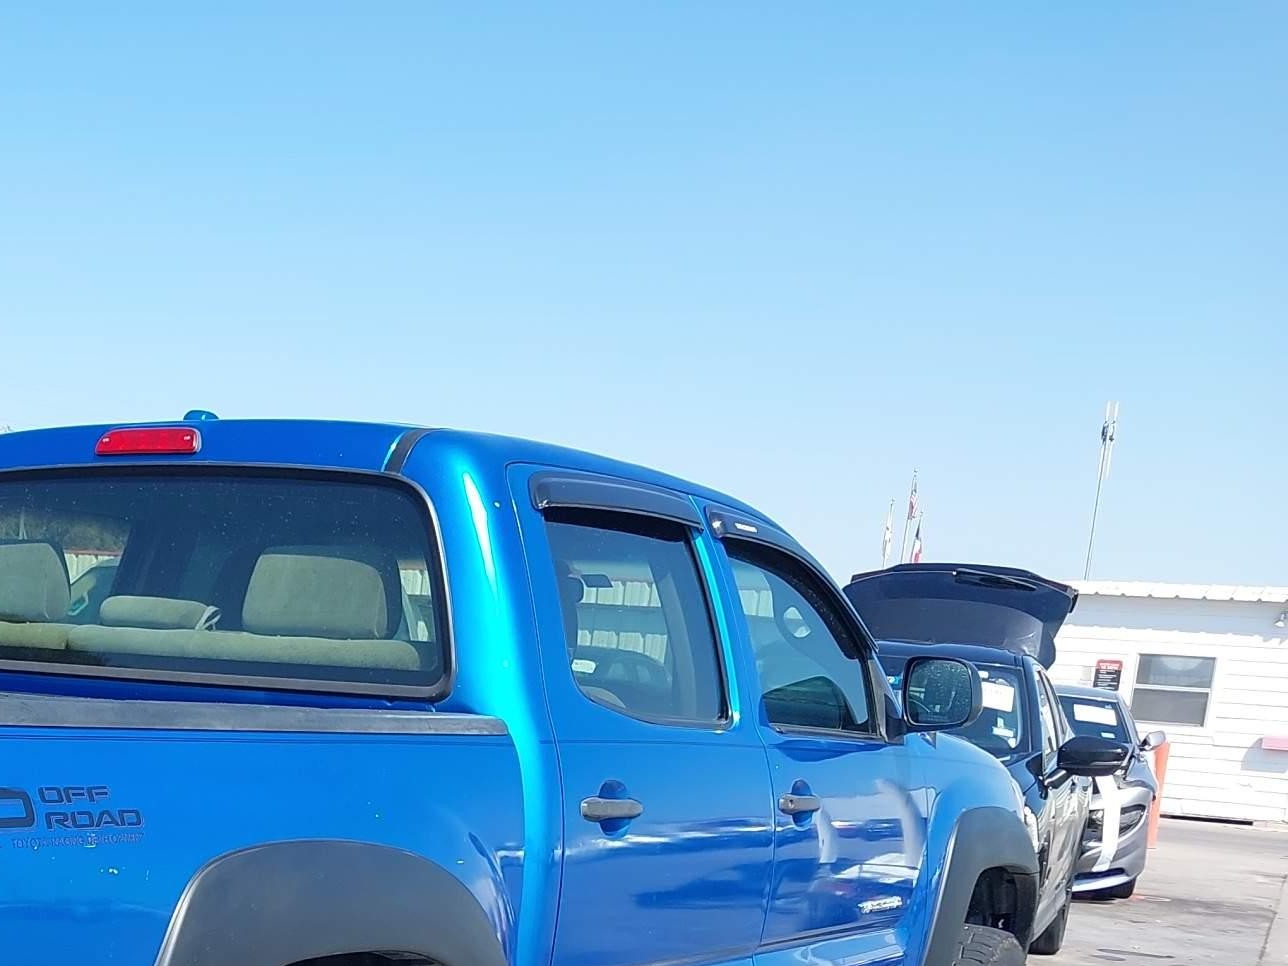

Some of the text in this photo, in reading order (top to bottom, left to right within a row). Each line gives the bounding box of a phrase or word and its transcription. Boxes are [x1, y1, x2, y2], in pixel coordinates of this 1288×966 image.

[38, 785, 109, 804] OFF
[45, 808, 143, 831] ROAD
[12, 838, 50, 849] TOYO
